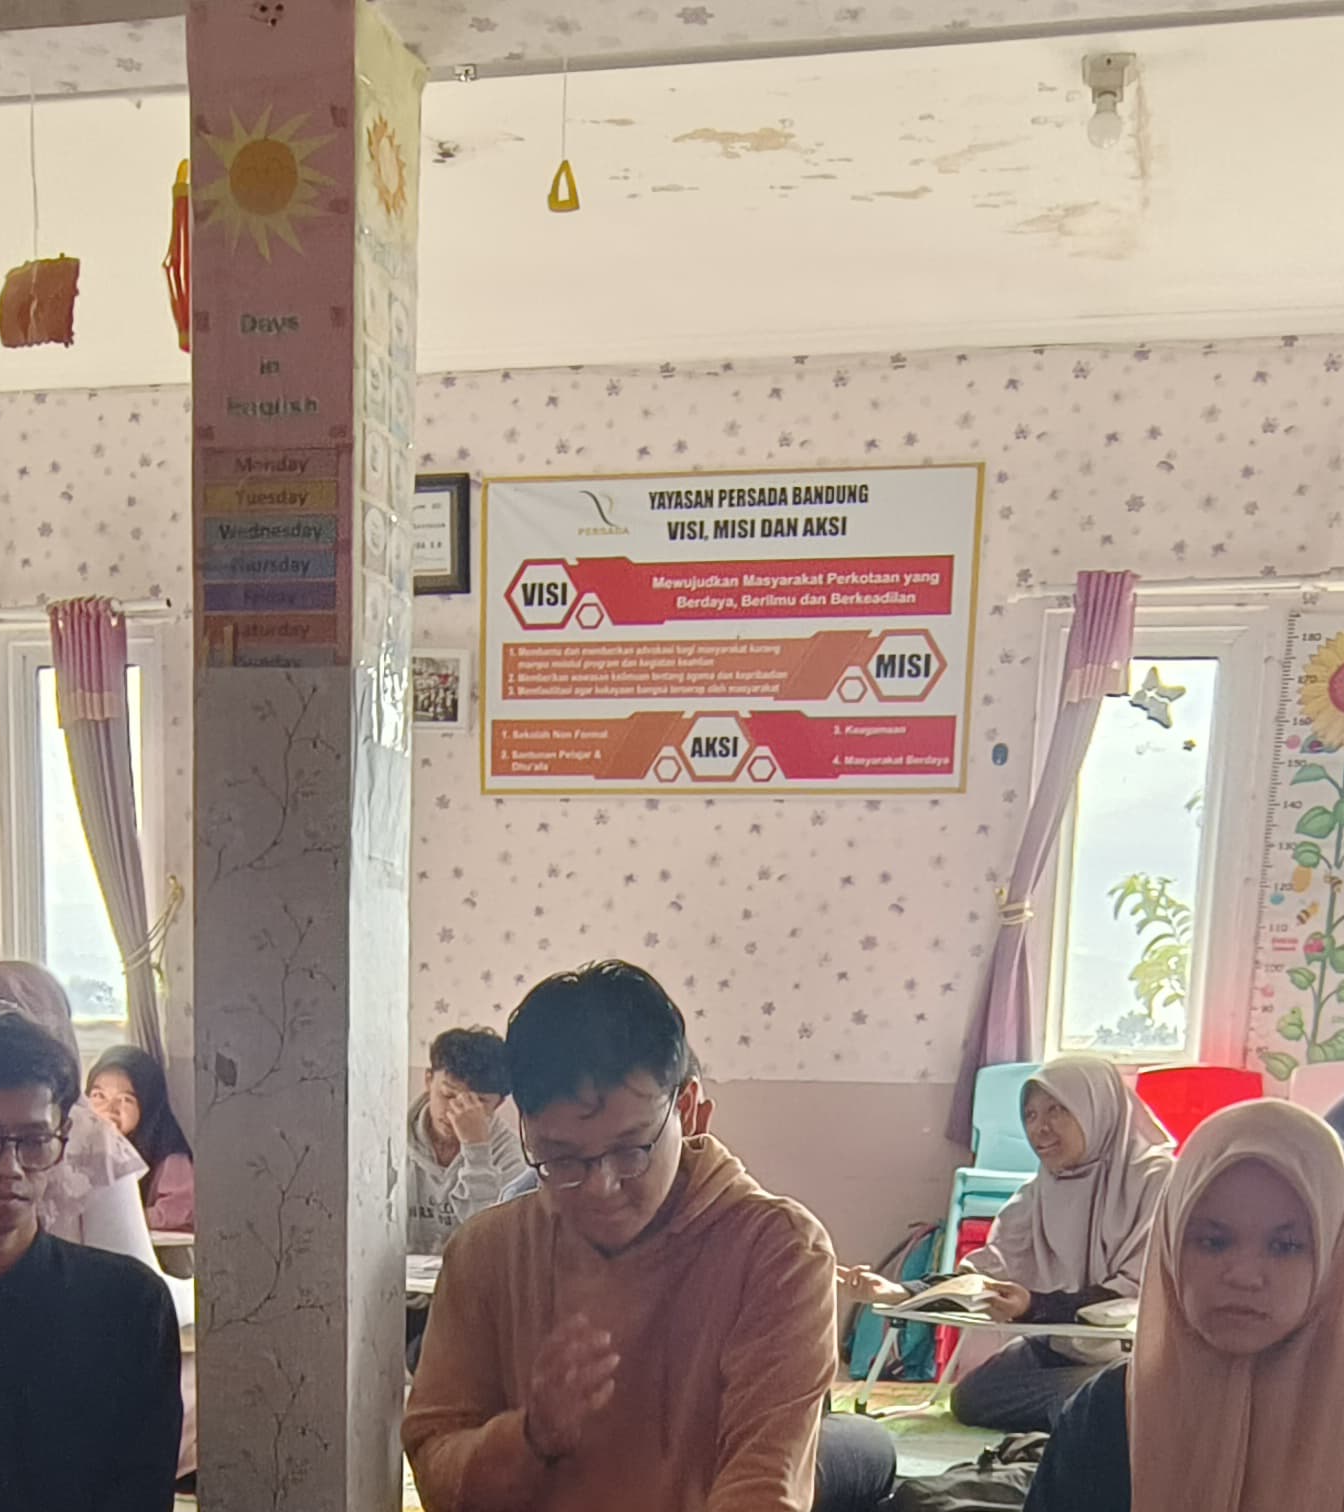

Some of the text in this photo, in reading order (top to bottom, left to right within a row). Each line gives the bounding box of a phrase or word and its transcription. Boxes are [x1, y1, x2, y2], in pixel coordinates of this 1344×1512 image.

[240, 313, 299, 335] Days
[227, 395, 319, 422] English
[235, 455, 309, 475] Monday
[236, 489, 310, 507] Tuesday
[648, 484, 869, 511] YAYASAN PERSADA BANDUNG
[219, 522, 323, 541] Wednesday
[577, 527, 630, 536] PERSADA
[667, 516, 847, 540] VISI, MISI DAN AKSI
[230, 557, 312, 576] Thursday
[652, 571, 940, 591] Mewujudkan Masyarakat Perkotaan yang
[521, 582, 568, 608] VISI
[676, 595, 738, 610] Berdaya,
[800, 592, 827, 606] dan
[831, 590, 916, 606] Berkeadilan
[233, 621, 310, 639] aturday
[875, 653, 931, 679] MISI
[690, 735, 738, 759] AKSI
